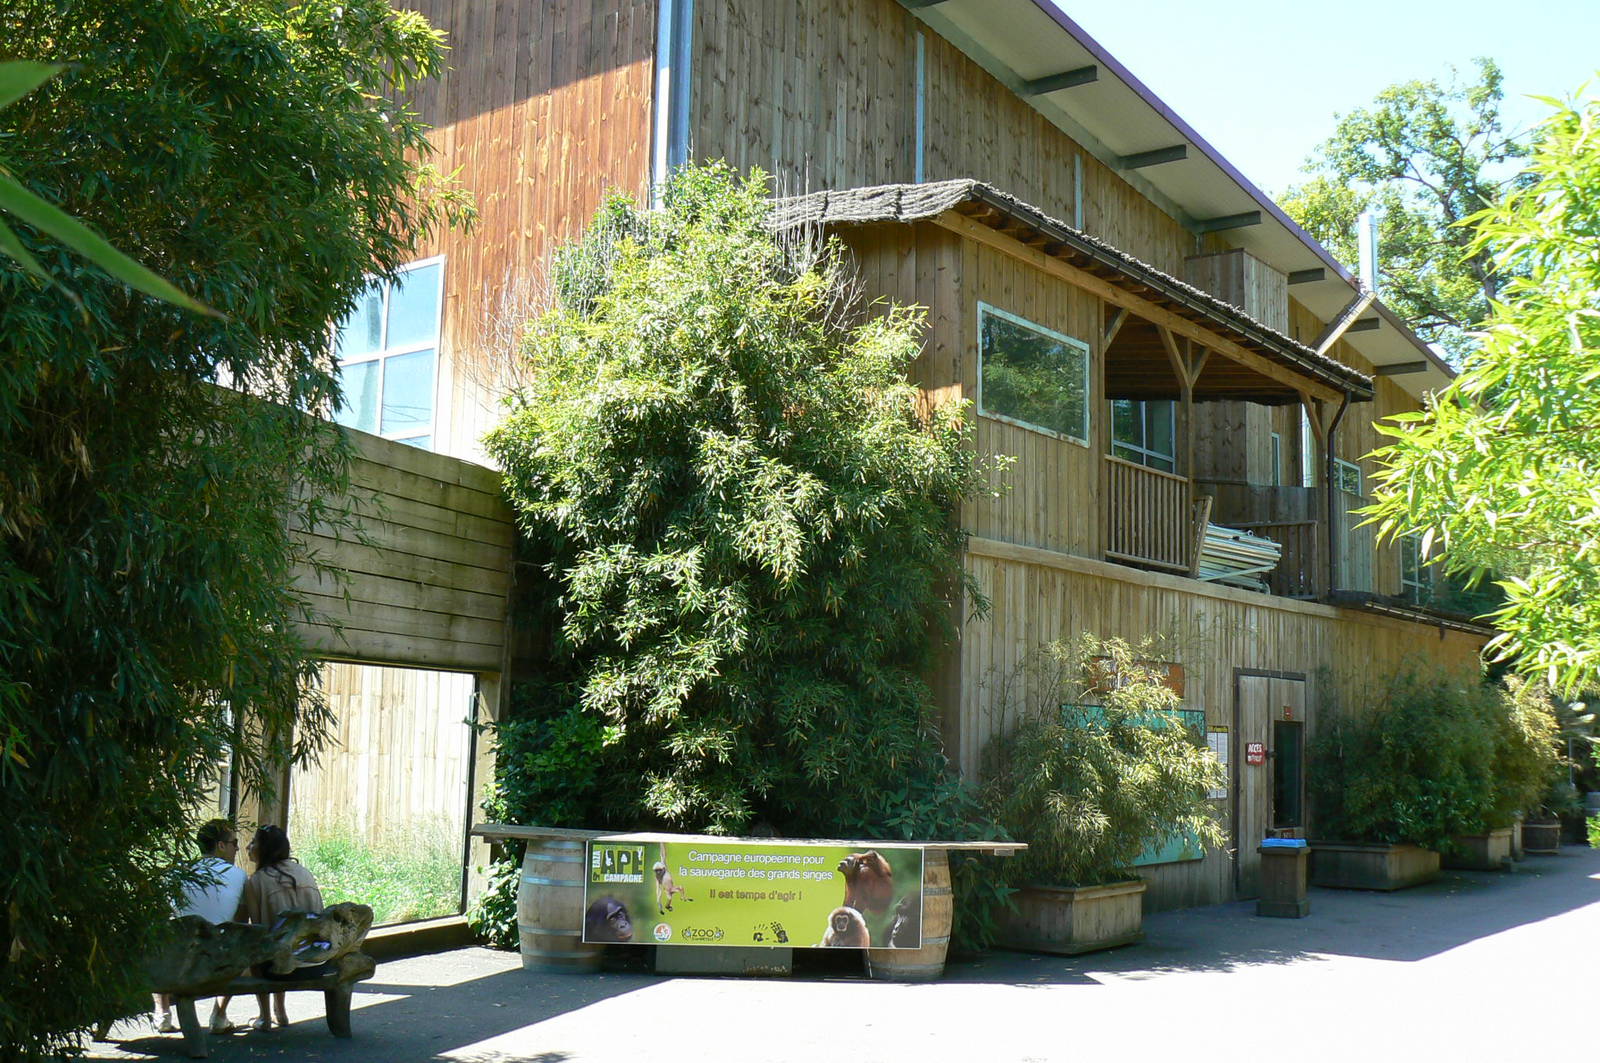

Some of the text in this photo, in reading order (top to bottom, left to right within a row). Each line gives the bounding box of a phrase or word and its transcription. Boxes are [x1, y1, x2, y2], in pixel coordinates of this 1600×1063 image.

[600, 849, 643, 875] APE
[688, 850, 742, 864] Campagne
[802, 855, 825, 866] pour
[604, 874, 643, 883] CAMPAGNE
[679, 866, 833, 882] la sauvegarde des grands singes
[718, 890, 734, 899] est
[736, 890, 766, 901] temps
[768, 890, 796, 902] d'agir
[692, 928, 715, 938] ZOO
